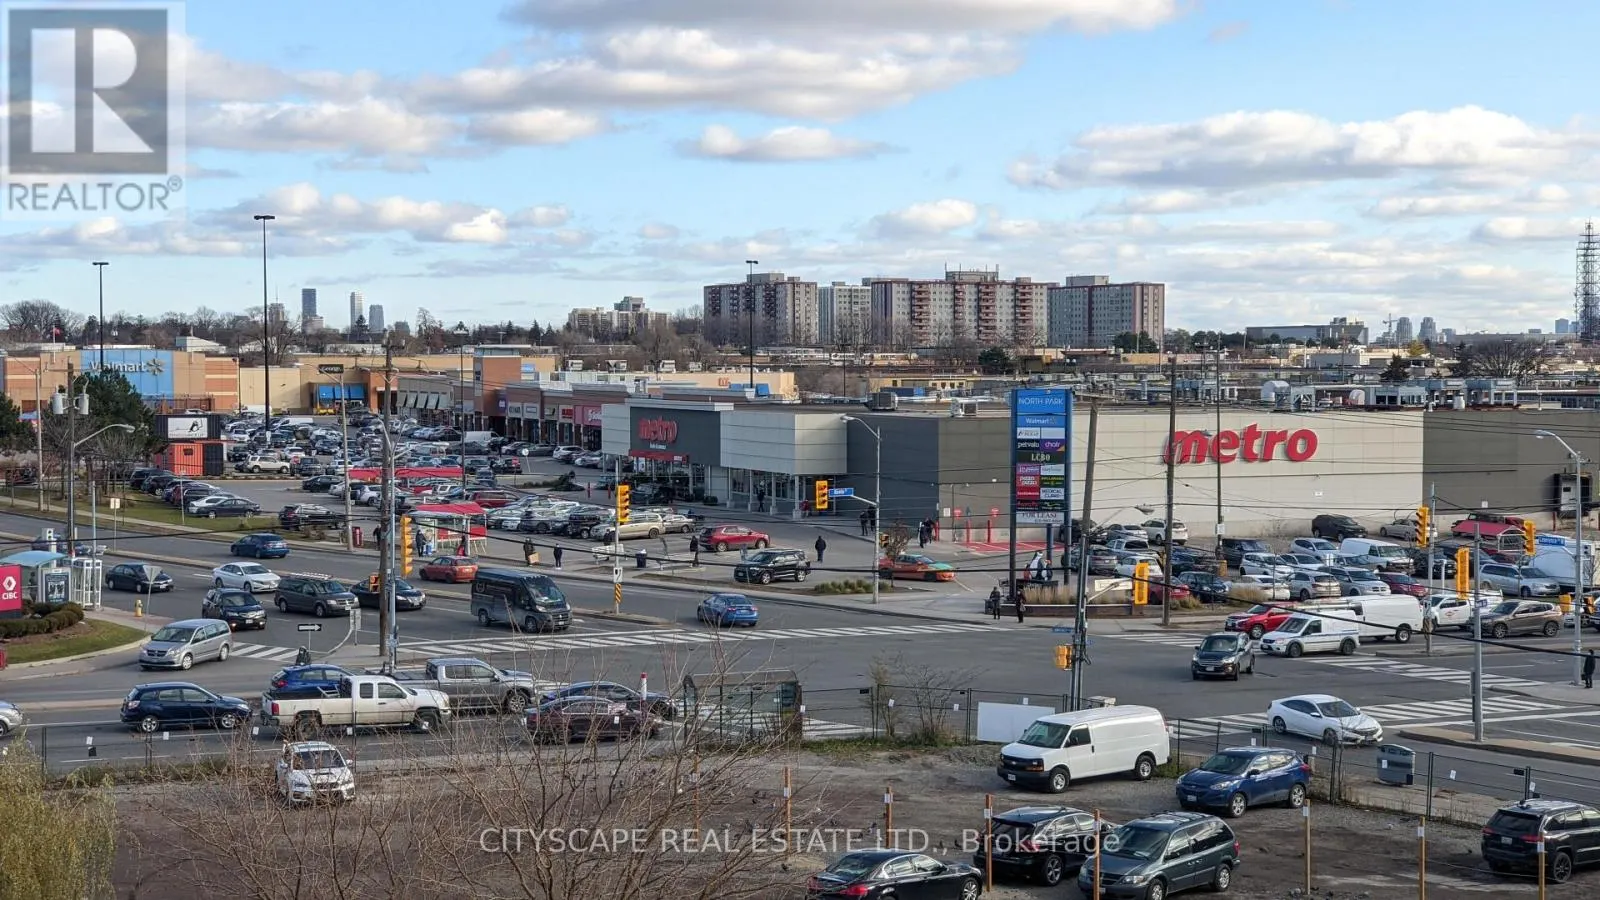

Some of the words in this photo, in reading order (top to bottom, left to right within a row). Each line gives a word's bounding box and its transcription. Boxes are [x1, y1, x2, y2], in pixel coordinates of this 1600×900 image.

[1018, 397, 1043, 405] NORTH
[1045, 397, 1064, 405] PARK
[638, 415, 678, 442] metro
[1162, 422, 1319, 464] metro
[1031, 453, 1051, 461] LCBO
[2, 592, 18, 600] CIBC
